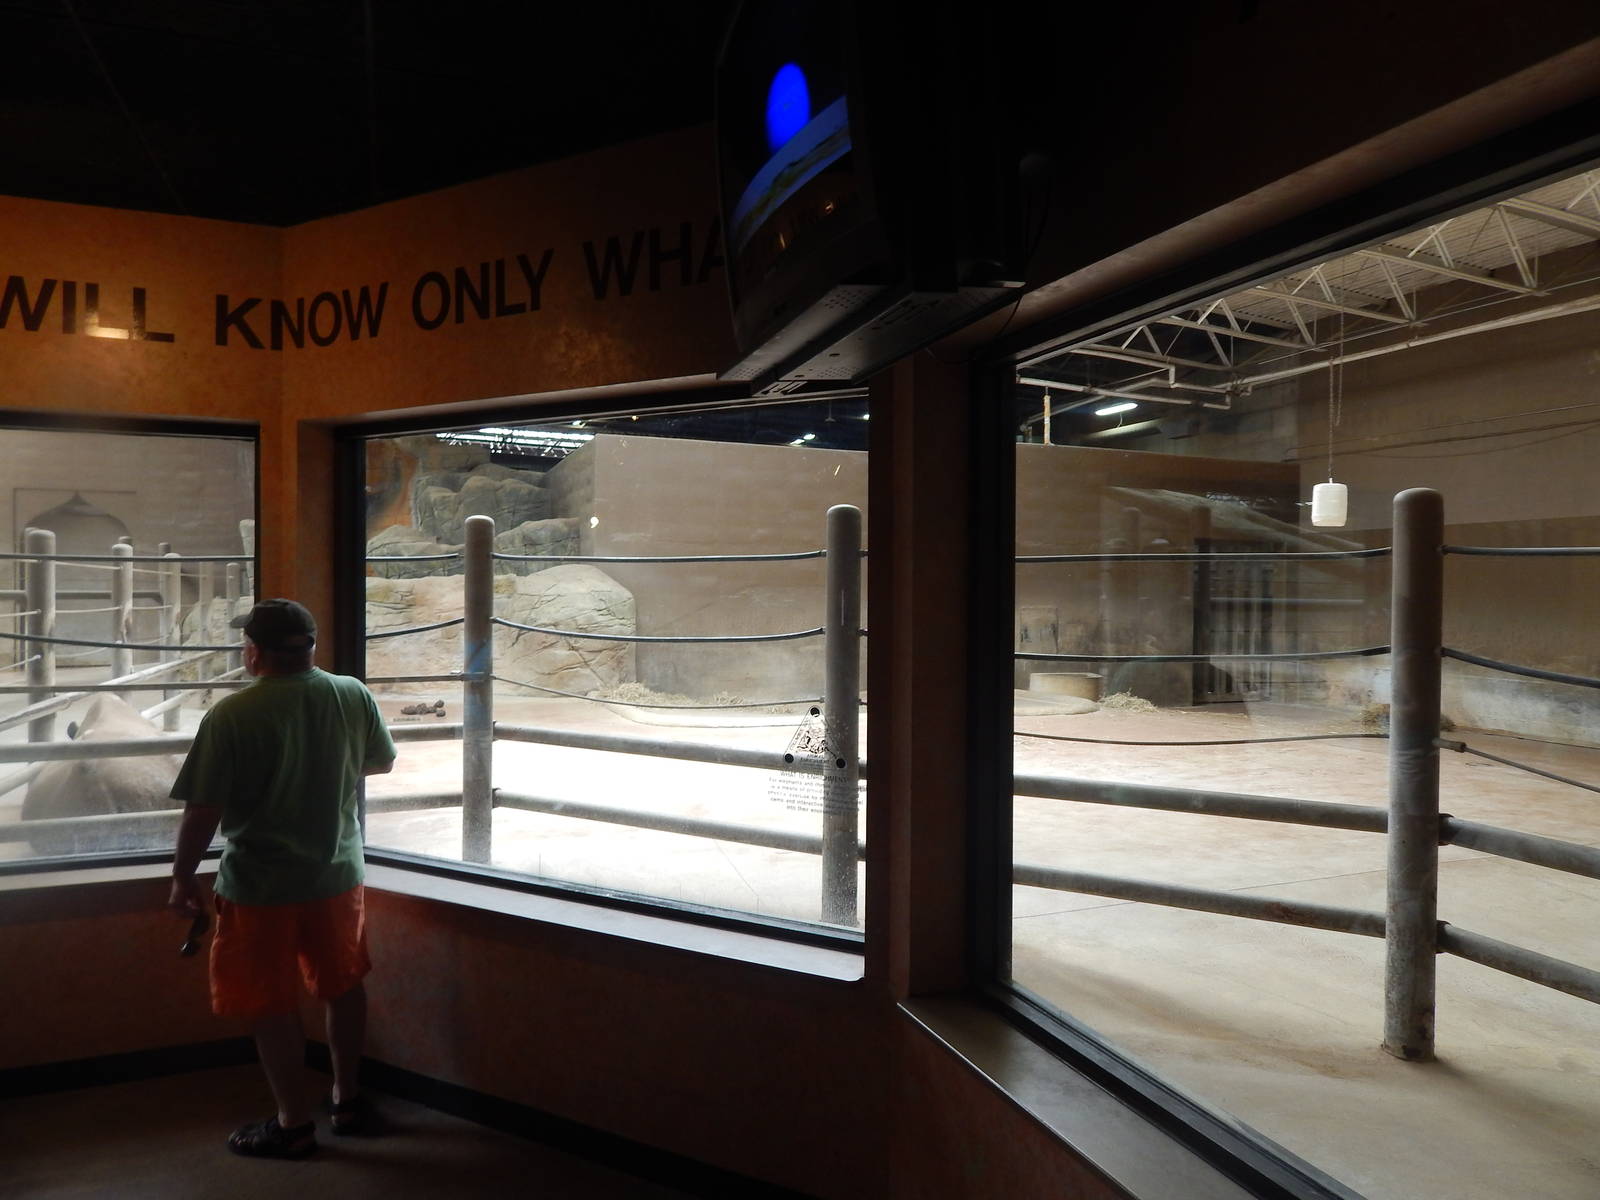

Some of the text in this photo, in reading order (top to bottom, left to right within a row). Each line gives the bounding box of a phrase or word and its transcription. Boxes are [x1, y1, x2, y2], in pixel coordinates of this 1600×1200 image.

[0, 276, 174, 342] WILL
[215, 281, 389, 350] KNOW
[413, 248, 554, 330] ONLY
